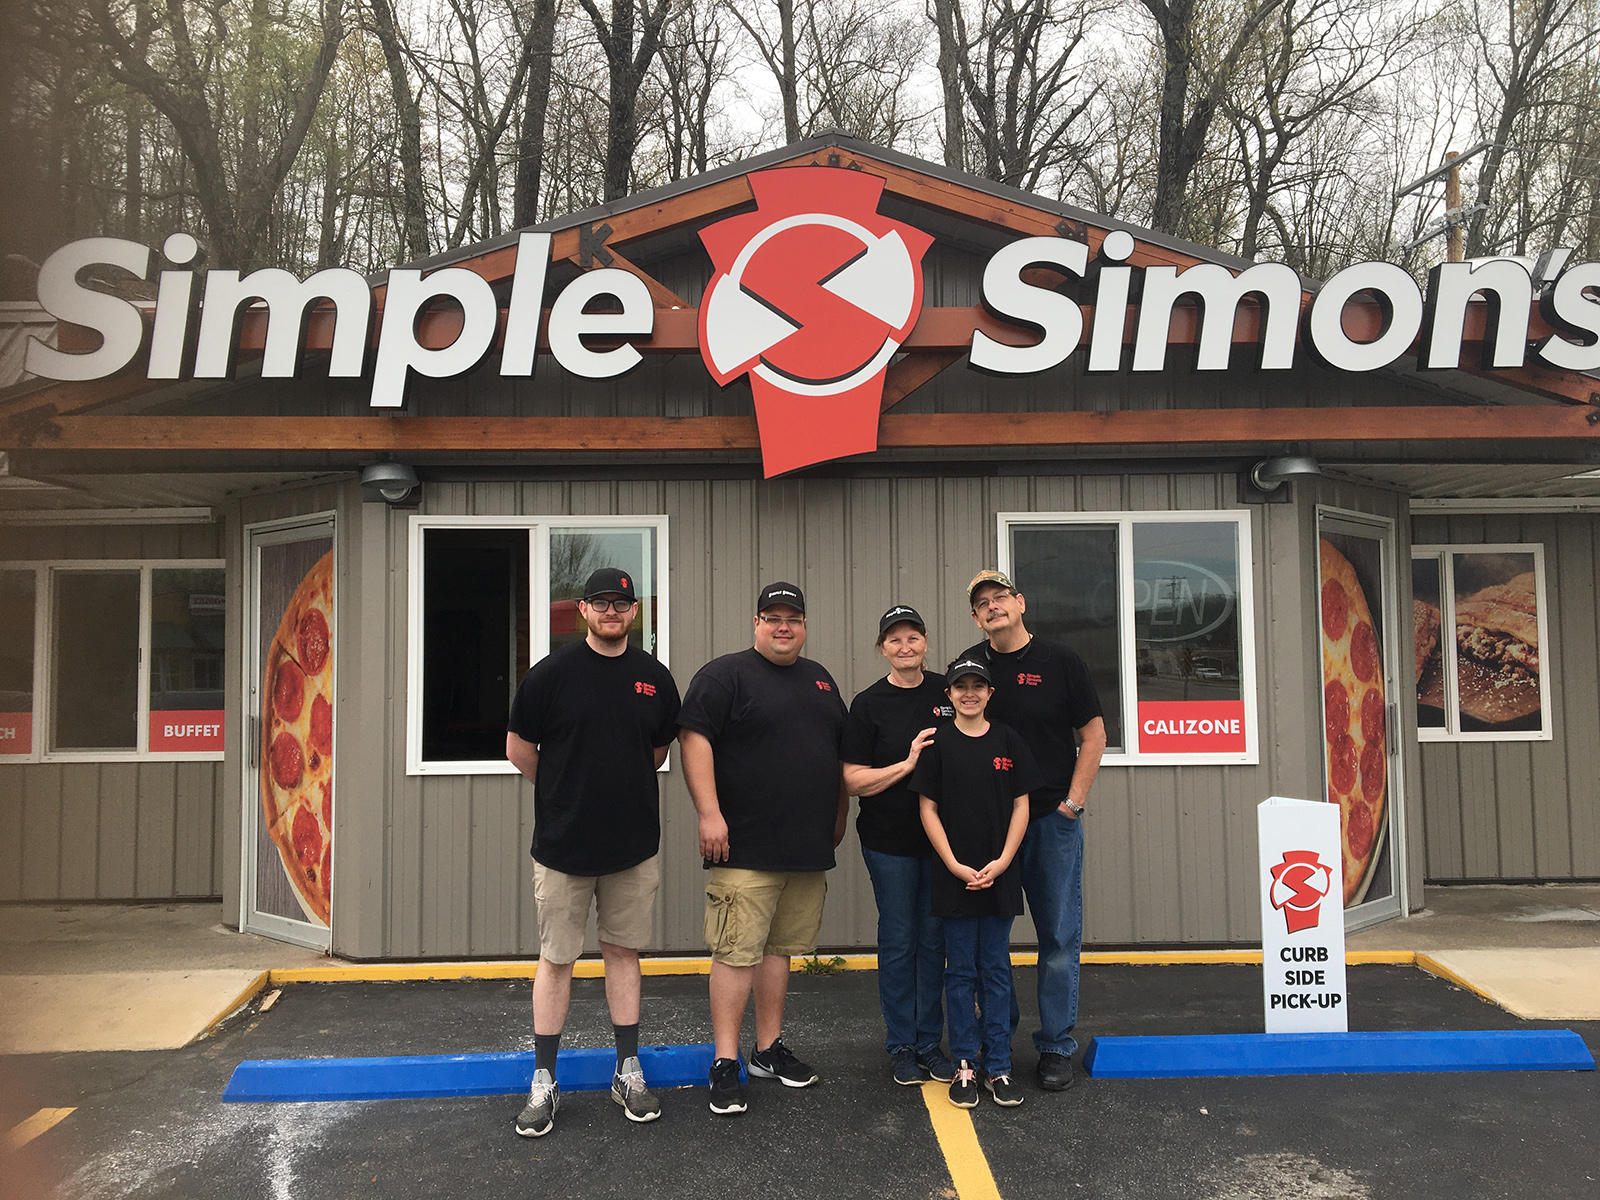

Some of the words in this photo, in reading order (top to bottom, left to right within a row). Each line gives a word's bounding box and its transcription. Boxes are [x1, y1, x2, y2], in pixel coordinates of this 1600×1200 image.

[25, 231, 654, 408] Simple
[969, 230, 1600, 374] Simon's
[163, 724, 221, 738] BUFFET
[1143, 719, 1241, 735] CALIZONE
[1280, 946, 1329, 963] CURB
[1284, 970, 1326, 986] SIDE
[1271, 993, 1342, 1010] PICK-UP
